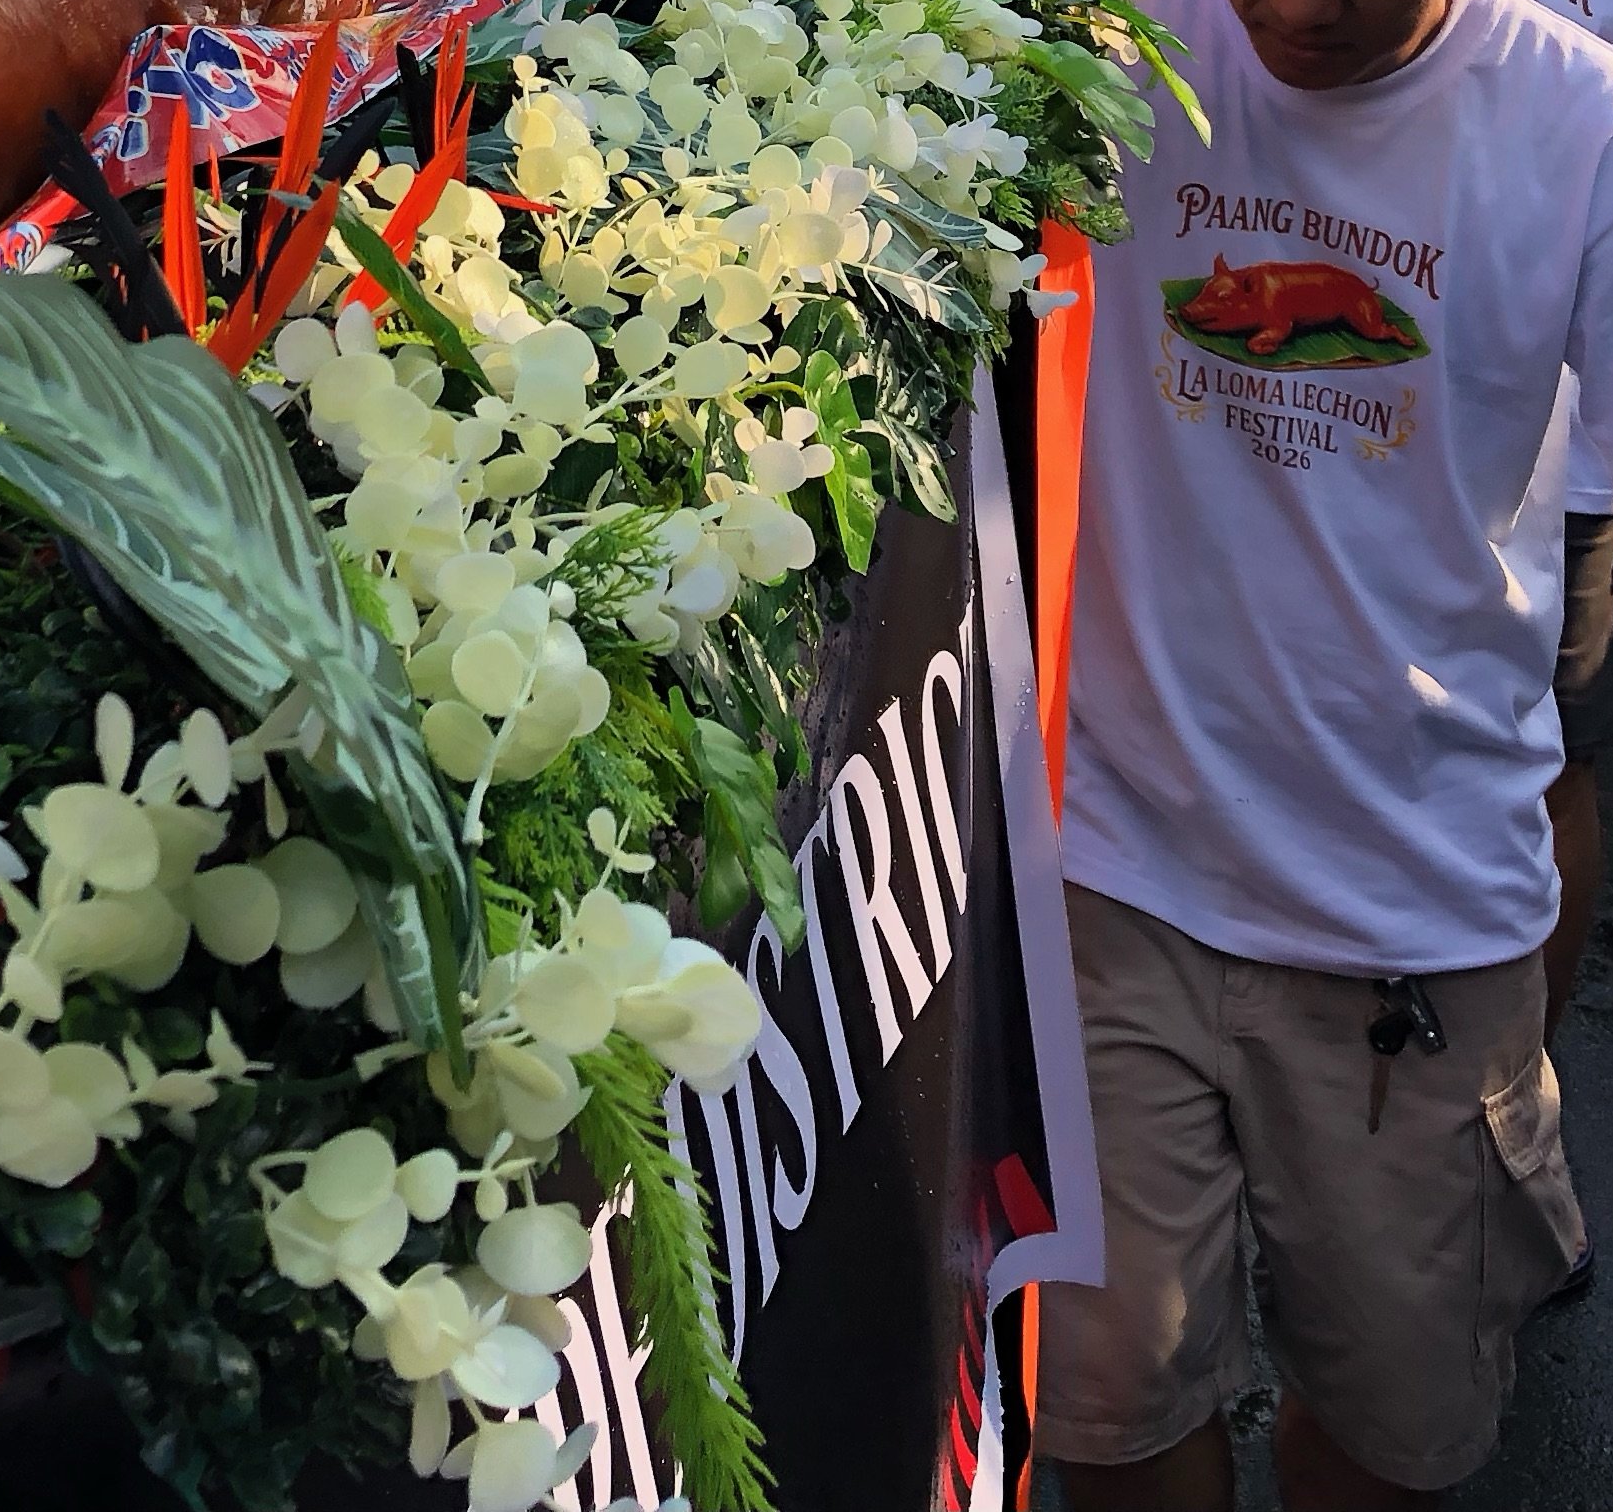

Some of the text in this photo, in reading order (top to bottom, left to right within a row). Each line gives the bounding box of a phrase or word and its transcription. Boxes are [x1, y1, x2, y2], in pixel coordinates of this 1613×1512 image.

[1175, 182, 1444, 300] PAANG BUNDOK
[1177, 359, 1393, 439] LA LOMA LECHON
[1225, 403, 1338, 454] FESTIVAL
[1251, 438, 1311, 470] 2026
[665, 583, 977, 1374] DISTRIC
